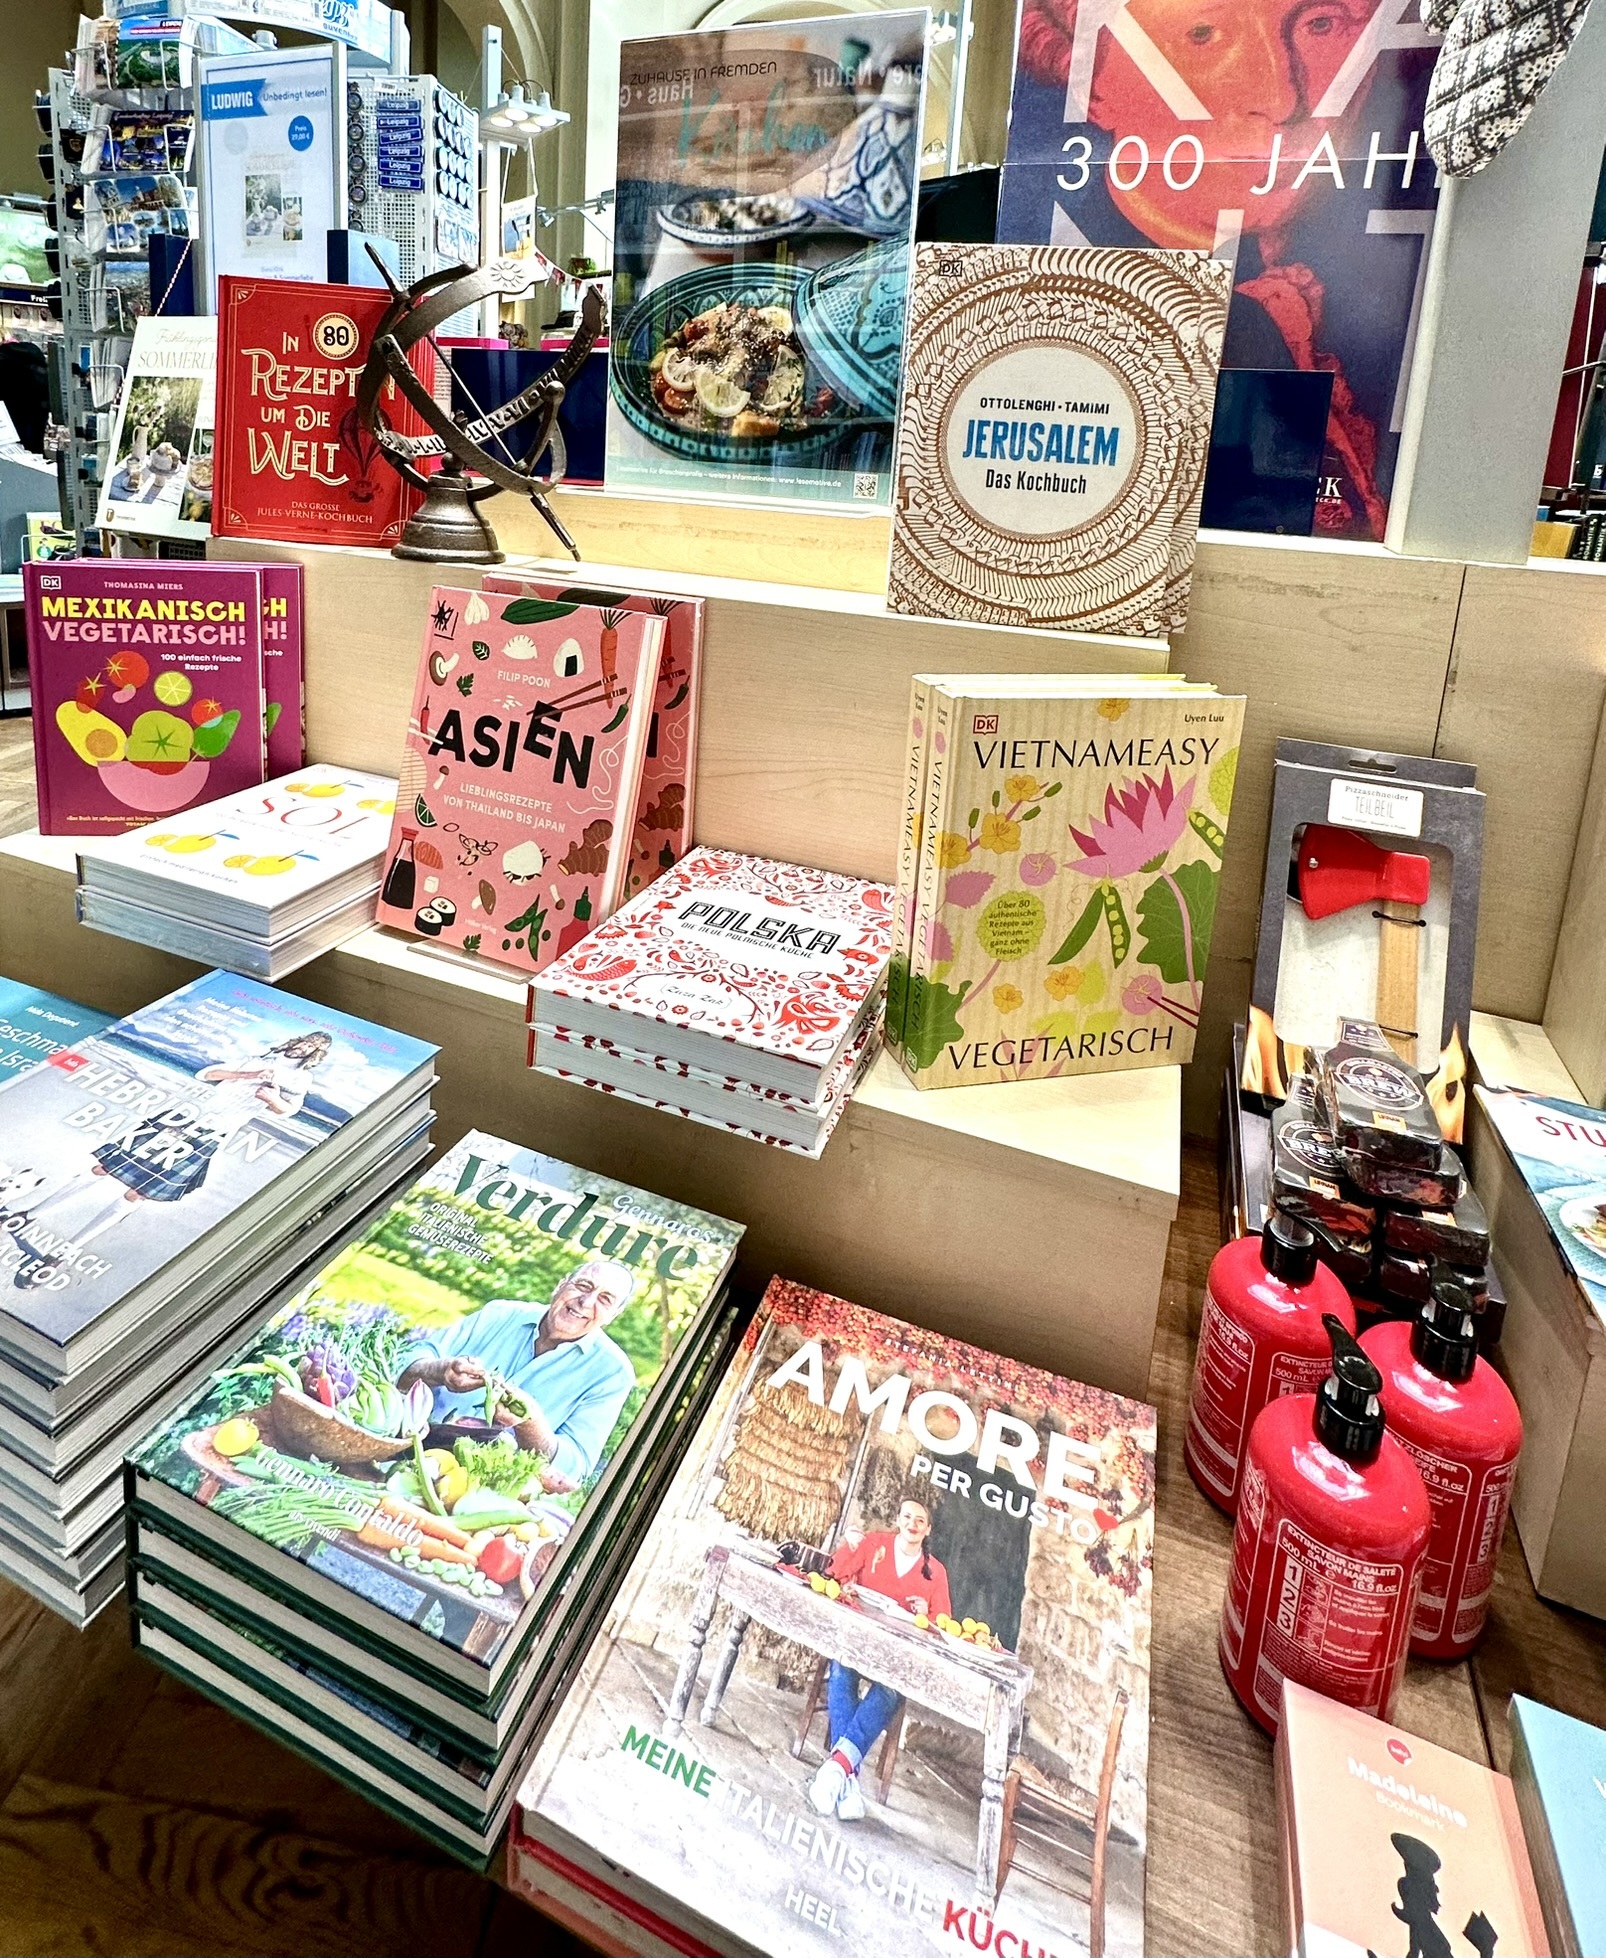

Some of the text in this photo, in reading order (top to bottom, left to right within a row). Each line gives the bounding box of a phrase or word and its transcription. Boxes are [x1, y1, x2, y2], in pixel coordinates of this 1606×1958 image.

[630, 61, 777, 85] ZUHAUSE IN FREMDEN
[211, 91, 254, 111] LUDWIG
[262, 87, 328, 103] Unbedingt lesen!
[387, 118, 409, 126] Leipzig
[388, 162, 411, 171] Leipzig
[1055, 131, 1442, 196] 300 JAH
[388, 178, 411, 187] Leipzig
[940, 261, 962, 276] DK
[283, 325, 349, 354] IN 80
[261, 405, 331, 431] UM DIE
[980, 397, 1110, 415] OTTOLENGHI TAMIMI
[962, 419, 1120, 466] JERUSALEM
[247, 427, 350, 486] WELT
[985, 469, 1087, 494] Das Kochbuch
[291, 501, 340, 511] DAS GROSSE
[41, 576, 61, 590] DK
[104, 581, 183, 590] THOMASINA MIERS
[41, 596, 246, 622] MEXIKANISCH
[42, 620, 247, 646] VEGETARISCH!
[161, 653, 242, 663] 100 einfach frische
[185, 663, 219, 672] Rezepte
[497, 670, 550, 688] FILIP POON
[974, 716, 998, 734] DK
[1184, 713, 1224, 724] Uyen Luu
[428, 700, 594, 789] ASIEN
[973, 737, 1220, 769] VIETNAMEASY
[460, 782, 552, 813] LIEBLINGSREZEPTE
[1345, 785, 1409, 802] Pizzaschneider
[236, 797, 369, 840] SOL
[443, 795, 566, 833] VON THAILAND BIS JAPAN
[1355, 796, 1395, 819] TEILBEIL
[922, 760, 944, 898] VIETNAMEASY
[988, 909, 1037, 919] authentische
[989, 920, 1020, 929] Rezepte
[678, 901, 841, 955] POLSKA
[681, 922, 698, 930] DIE
[698, 926, 722, 937] NEUE
[725, 932, 777, 950] POLNISCHE
[990, 938, 1030, 948] ganz ohne
[995, 947, 1022, 955] Fleisch
[948, 1025, 1173, 1070] VEGETARISCH
[65, 1063, 279, 1164] HEBRIDEAN
[63, 1102, 195, 1171] BAKER
[430, 1201, 479, 1228] ORIGINAL
[454, 1153, 698, 1280] Verdure
[612, 1194, 718, 1244] Gennaros
[419, 1213, 488, 1245] ITALIENISCHE
[0, 1243, 71, 1291] ACLEOD
[884, 1337, 952, 1368] STEFANIA
[1275, 1367, 1309, 1382] 500 mL
[765, 1340, 1101, 1509] AMORE
[255, 1446, 424, 1547] Gennaro Contaldo
[1441, 1477, 1465, 1492] fl.oz
[910, 1453, 1100, 1546] PER GUSTO
[1287, 1524, 1347, 1568] EXTINCTEUR
[1348, 1562, 1361, 1572] DE
[1281, 1537, 1398, 1594] 500 mL 16.9 fl.oz
[1306, 1549, 1375, 1583] SAVON MAINS
[1282, 1587, 1296, 1608] 2
[1279, 1610, 1292, 1630] 3
[619, 1725, 1062, 1958] MEINE ITALIENISCHE KÜCH
[784, 1885, 845, 1937] HEEL
